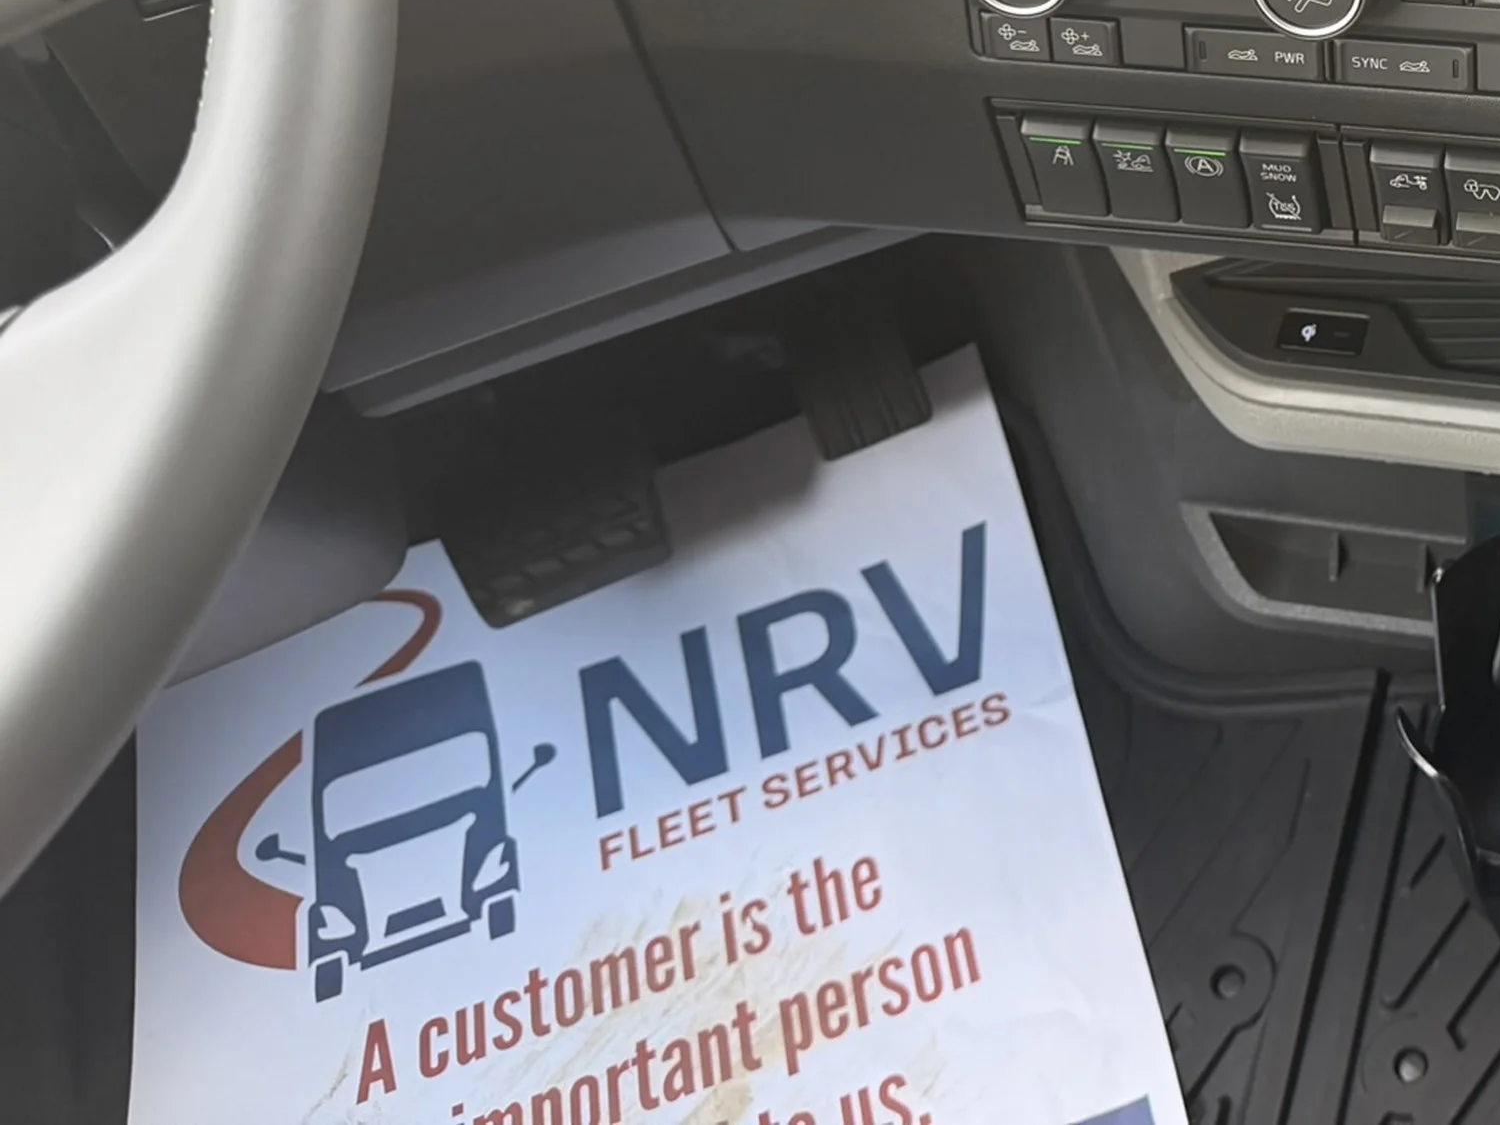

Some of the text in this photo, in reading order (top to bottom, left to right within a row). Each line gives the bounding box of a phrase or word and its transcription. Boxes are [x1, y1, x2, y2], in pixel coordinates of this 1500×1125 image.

[1274, 51, 1305, 64] PWR
[1351, 56, 1388, 70] SYNC
[1260, 172, 1297, 183] SNOW
[1261, 163, 1292, 173] MUD
[576, 519, 988, 820] NRV
[598, 691, 1013, 872] FLEET SERVICES
[354, 855, 884, 1106] A customer is the
[451, 925, 984, 1125] ortant person
